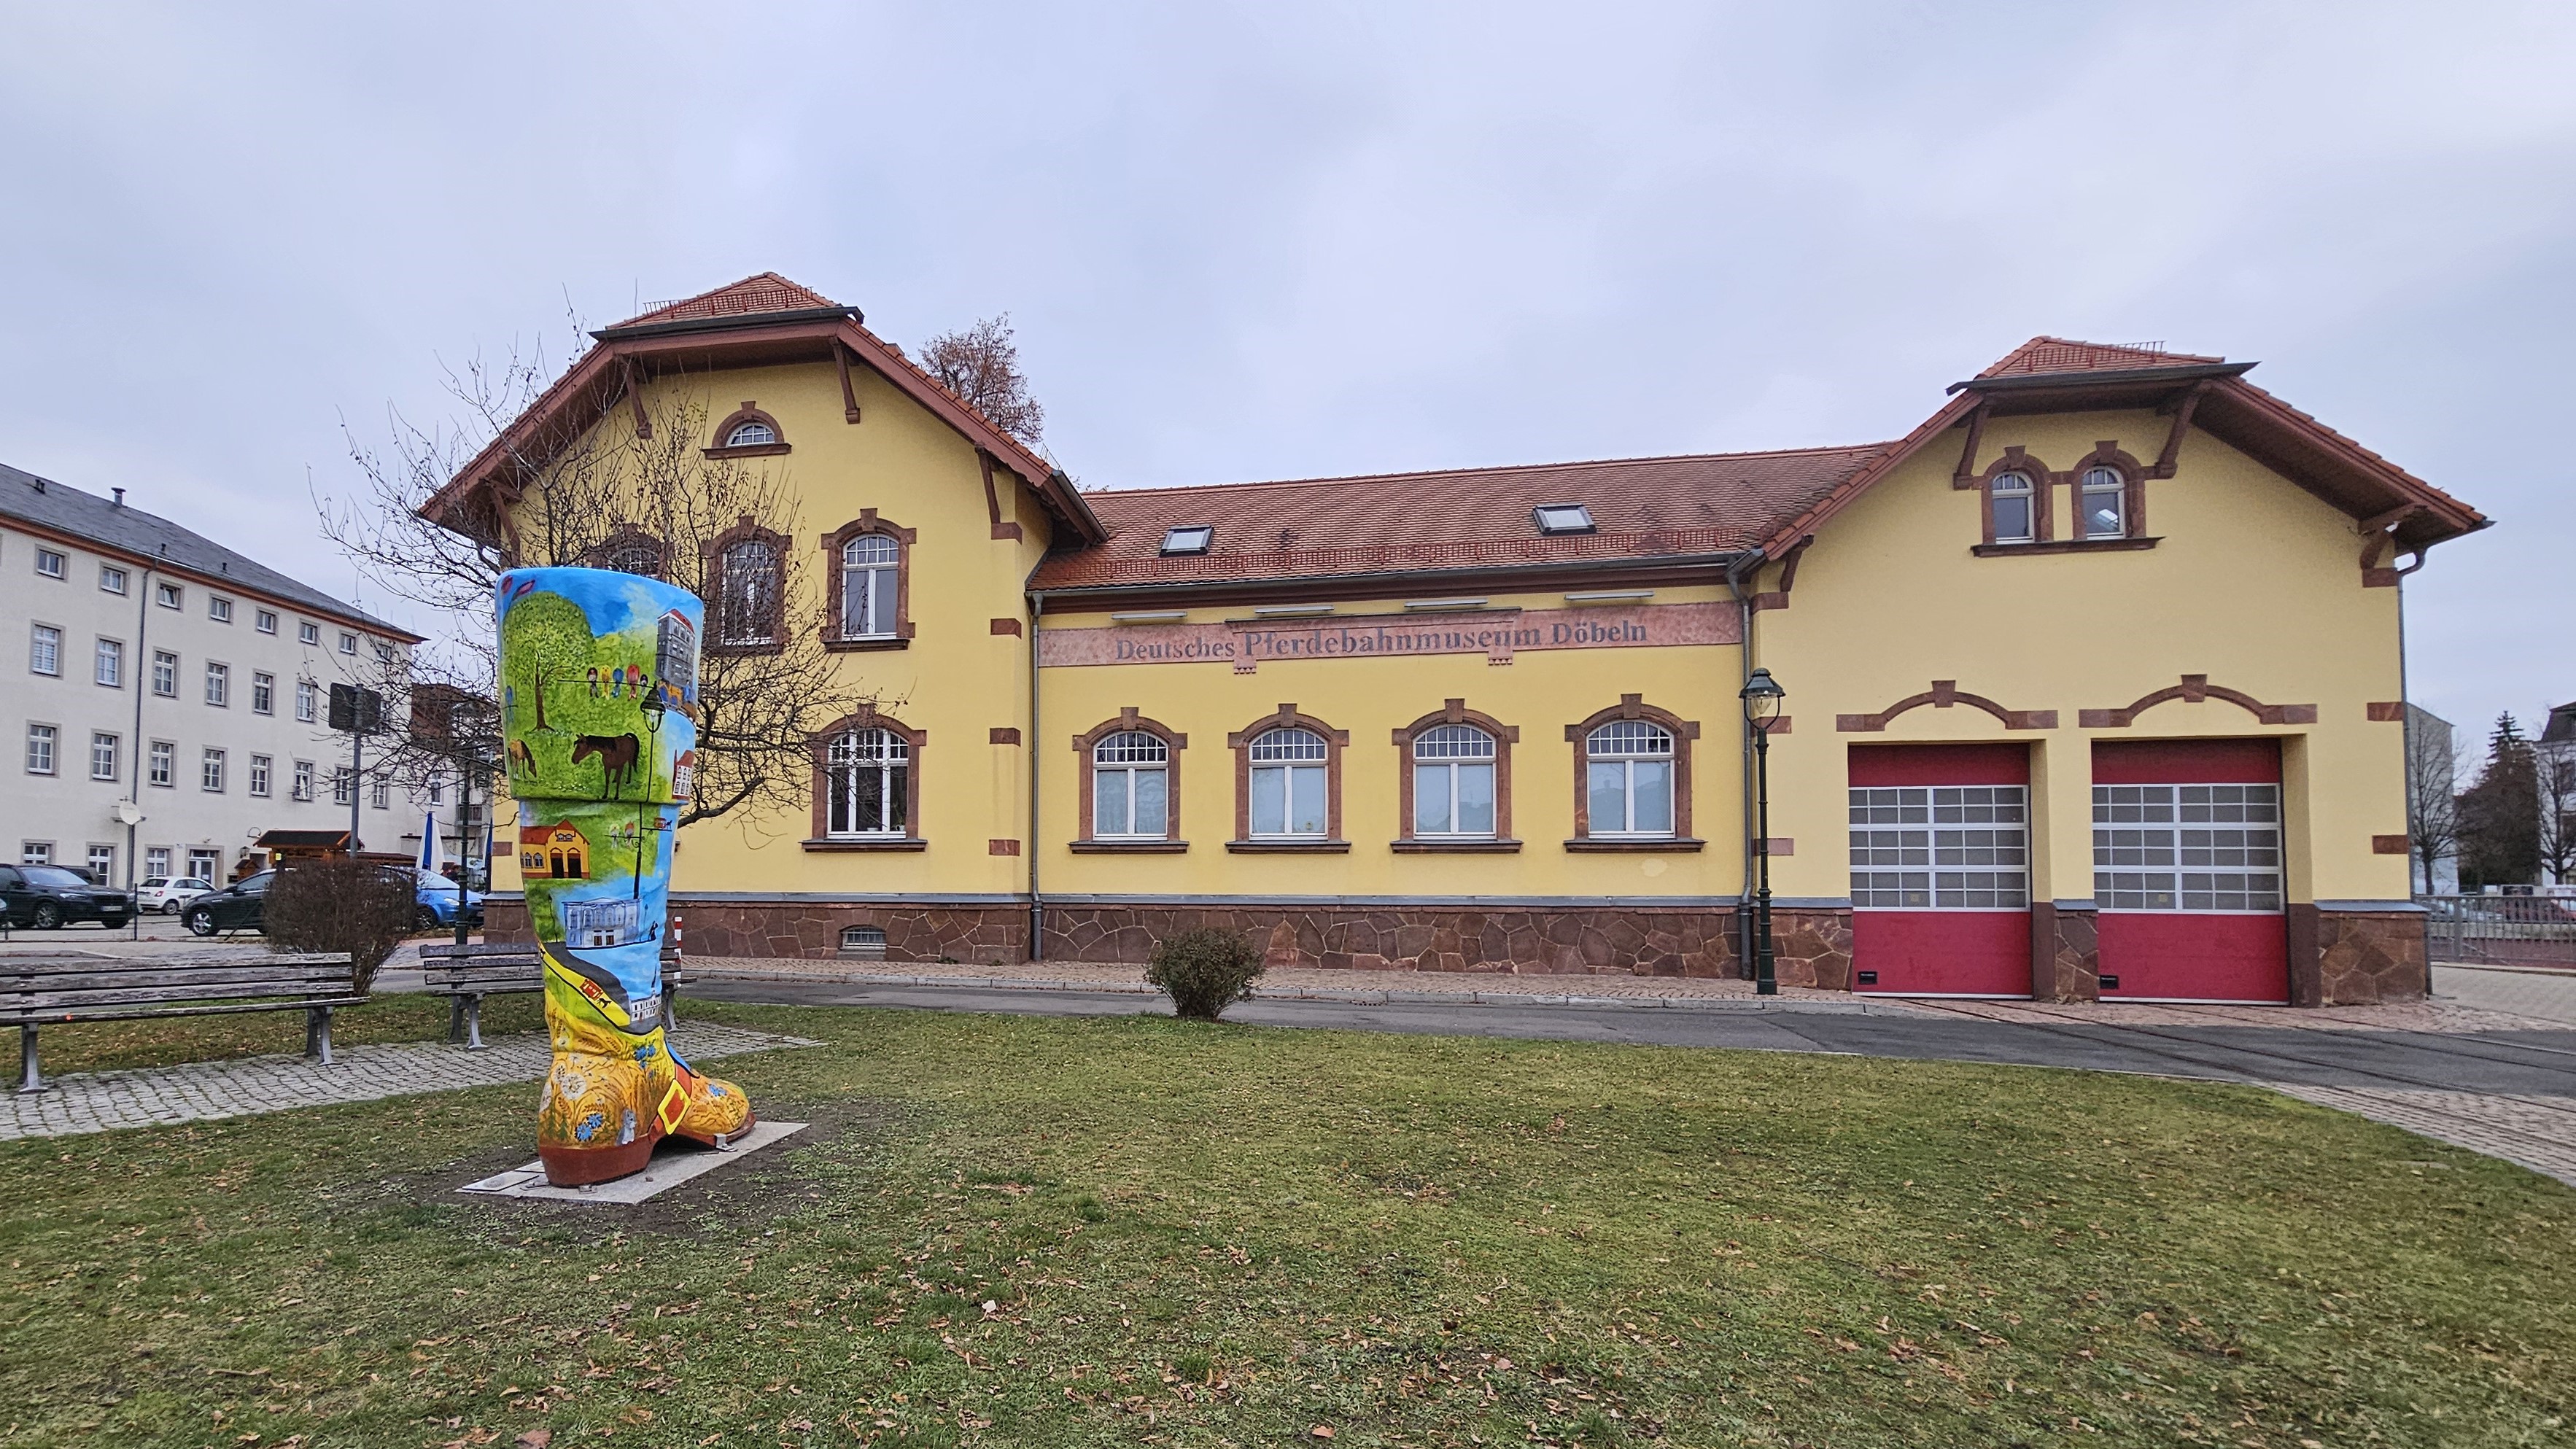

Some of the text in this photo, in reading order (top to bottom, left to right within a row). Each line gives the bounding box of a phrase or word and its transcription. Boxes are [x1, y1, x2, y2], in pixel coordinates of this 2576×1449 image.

[1116, 620, 1647, 659] Deutsches Pferdebahnmuseum Döbeln
